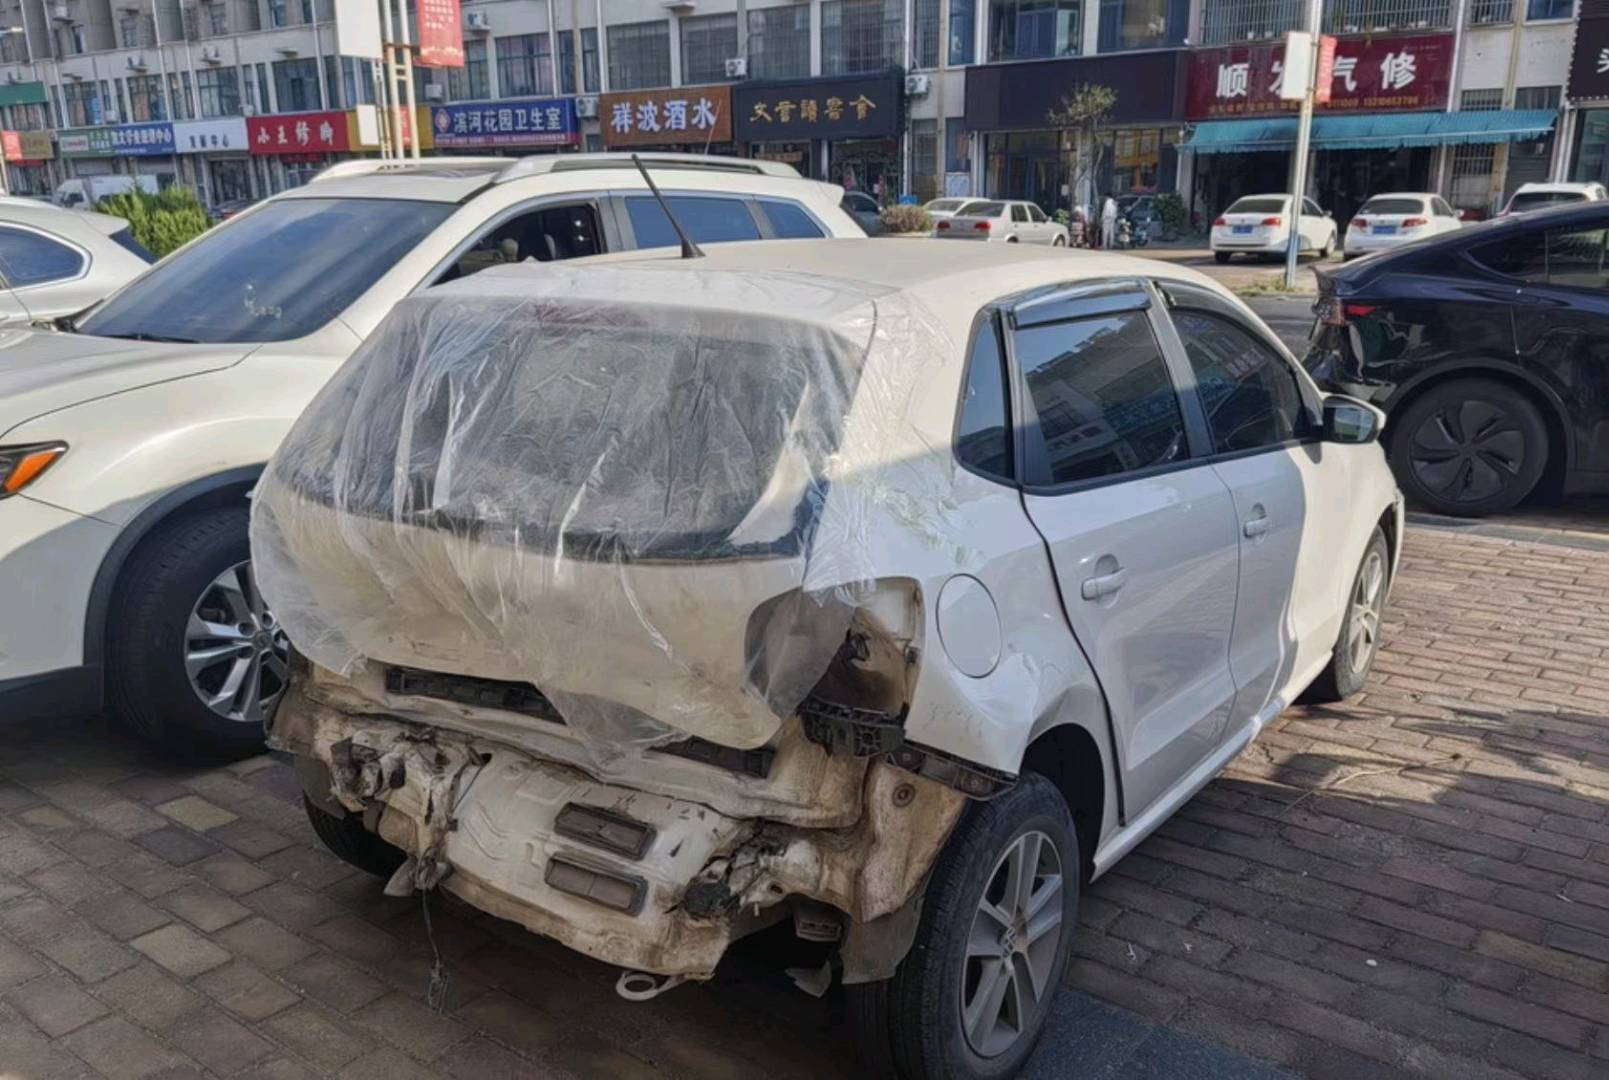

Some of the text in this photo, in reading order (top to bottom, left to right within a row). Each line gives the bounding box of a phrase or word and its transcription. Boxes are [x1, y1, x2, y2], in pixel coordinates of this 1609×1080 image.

[453, 107, 562, 133] 滨河花园卫生室
